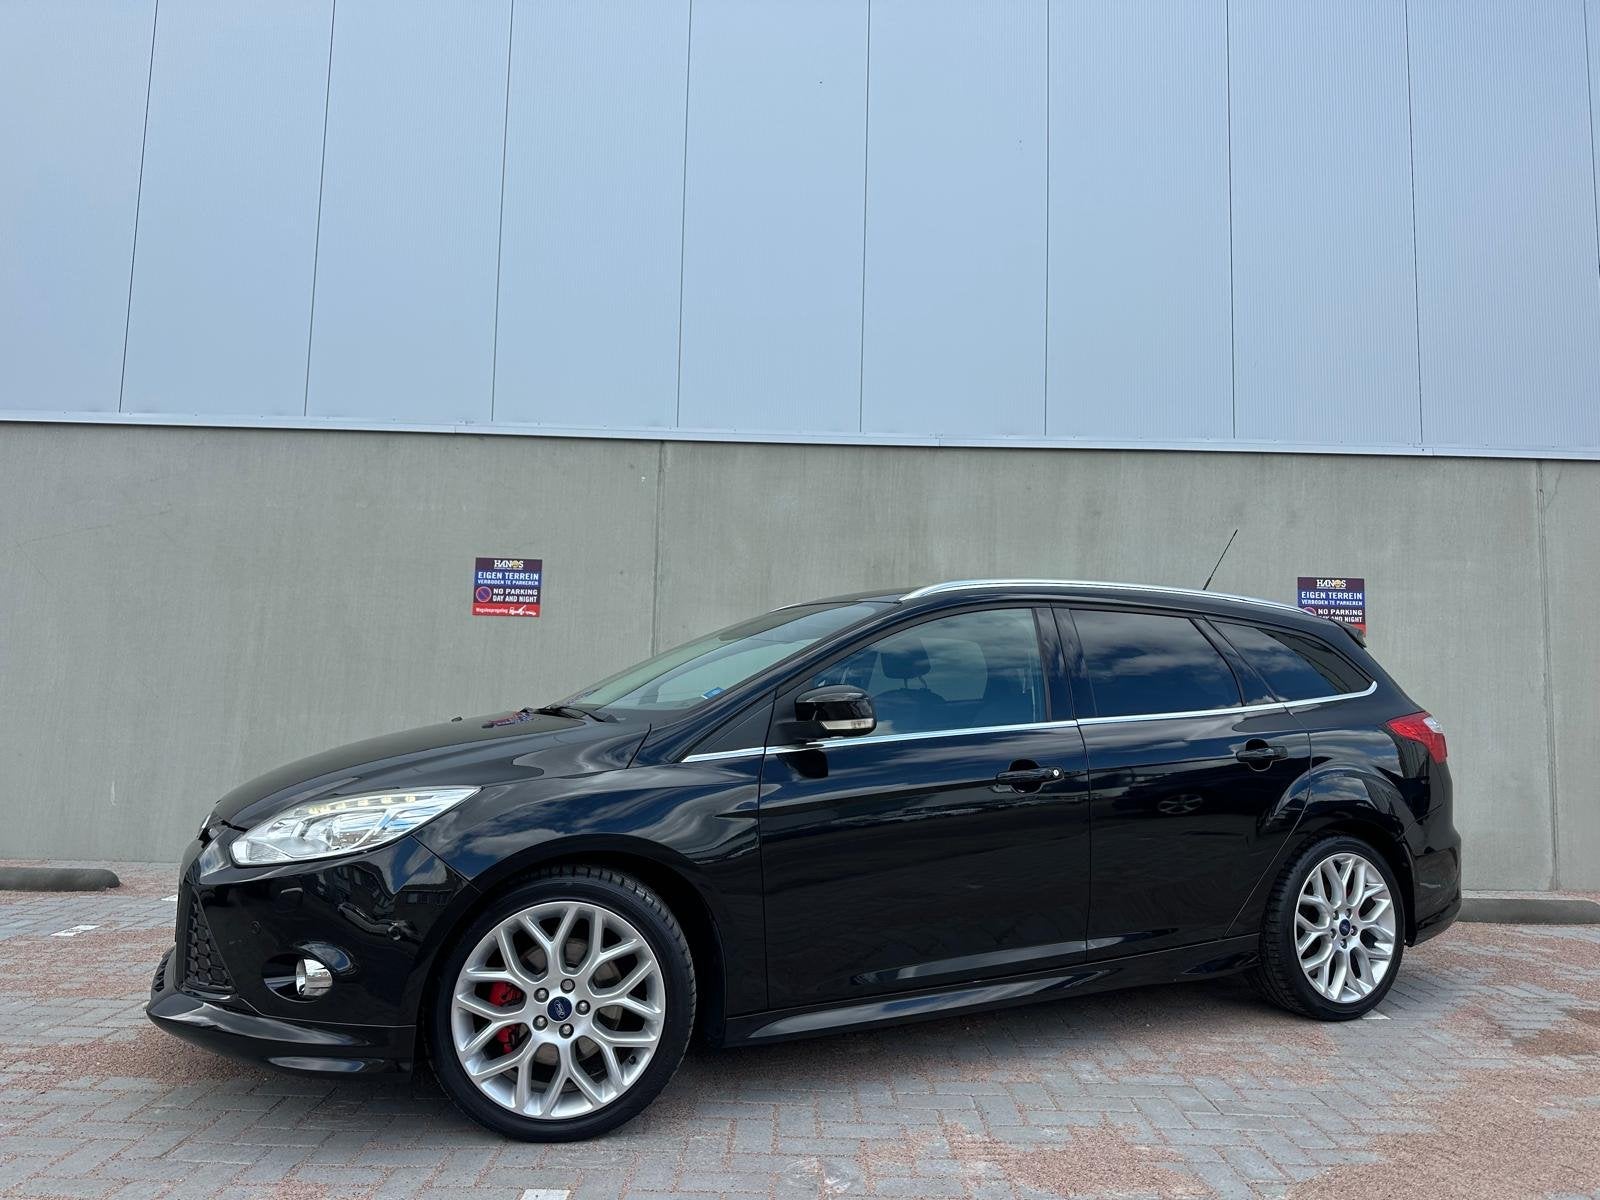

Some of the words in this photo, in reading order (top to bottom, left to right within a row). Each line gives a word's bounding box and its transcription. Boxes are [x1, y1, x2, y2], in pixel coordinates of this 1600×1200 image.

[494, 560, 524, 568] HANOS
[478, 571, 502, 579] EIGEN
[505, 572, 539, 580] TERREIN
[1316, 579, 1346, 588] HANOS
[1301, 591, 1326, 599] EIGEN
[1328, 592, 1362, 600] TERREIN
